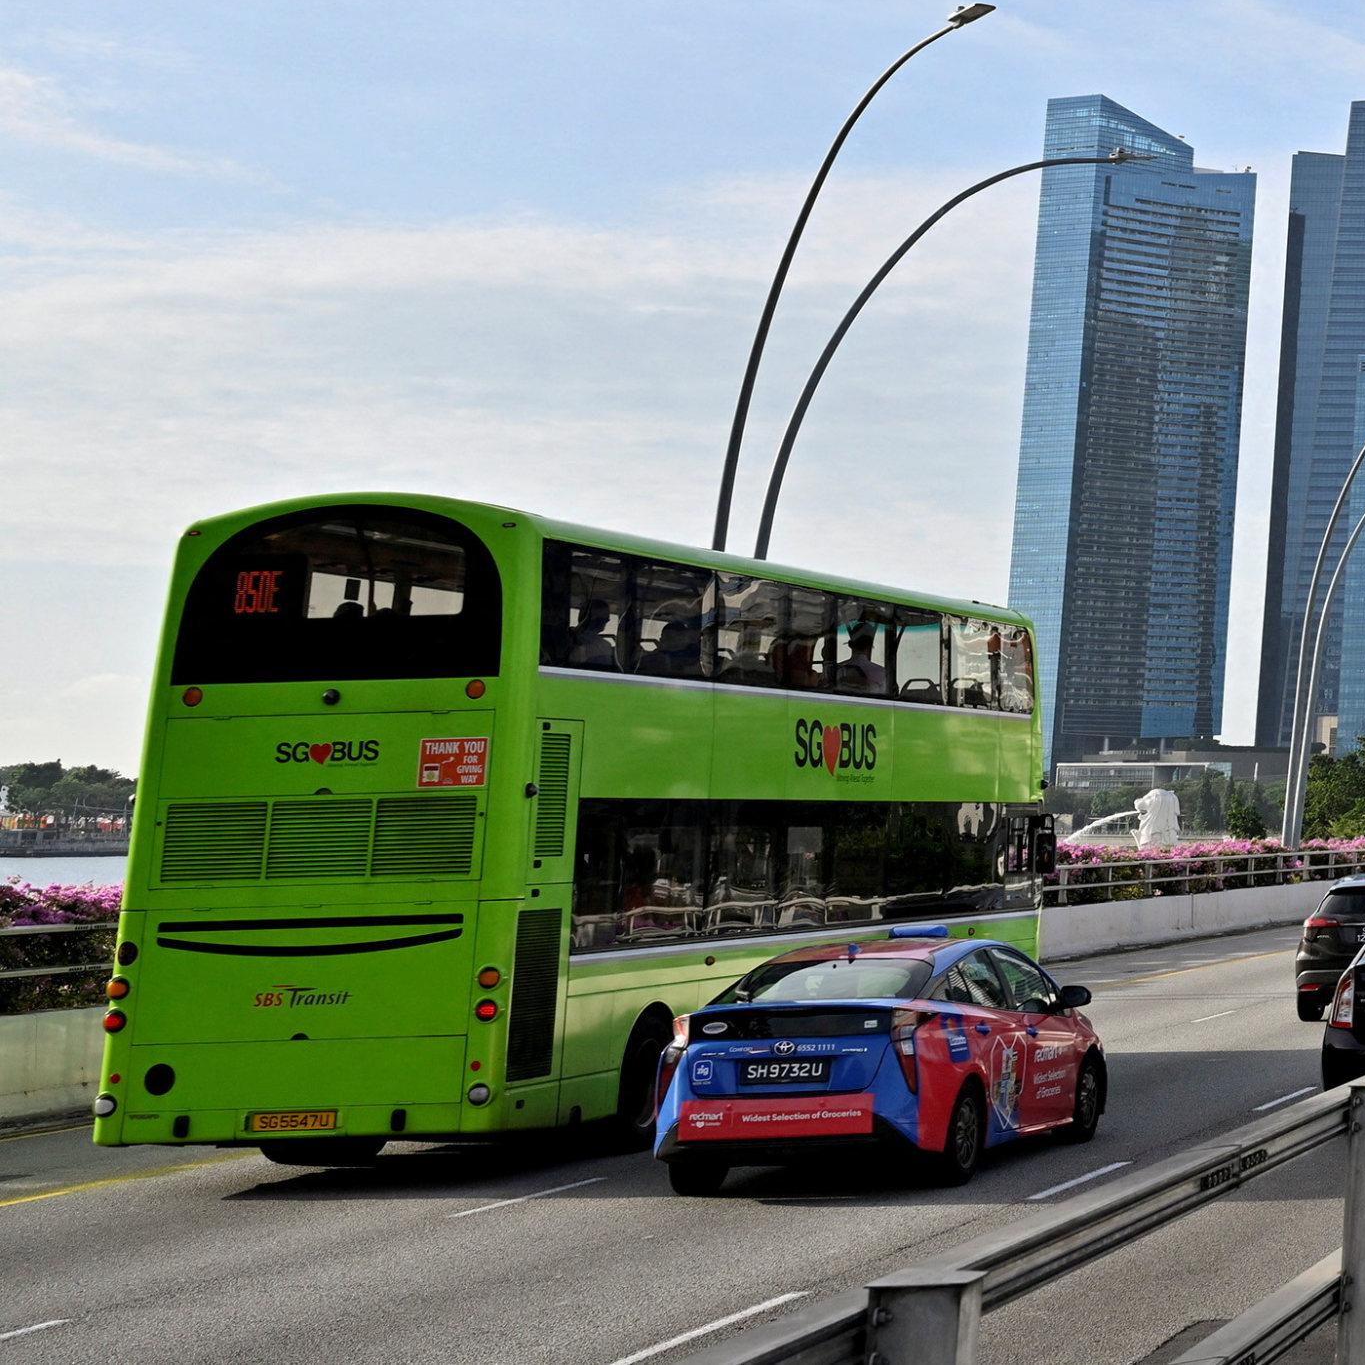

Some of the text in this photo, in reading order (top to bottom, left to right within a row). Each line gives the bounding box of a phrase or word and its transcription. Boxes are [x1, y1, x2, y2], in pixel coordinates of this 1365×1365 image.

[234, 571, 283, 613] 850E
[425, 741, 485, 755] THANK YOU
[463, 755, 478, 764] FOR
[456, 764, 483, 774] GIVING
[461, 775, 478, 783] WAY
[253, 987, 353, 1009] SBS Transit
[797, 1044, 816, 1052] 6552
[697, 1064, 709, 1076] zig
[747, 1063, 823, 1079] SH9732U
[258, 1114, 330, 1129] SG5547U
[689, 1112, 724, 1121] redmart
[742, 1109, 862, 1123] Widest Selection of Groceries
